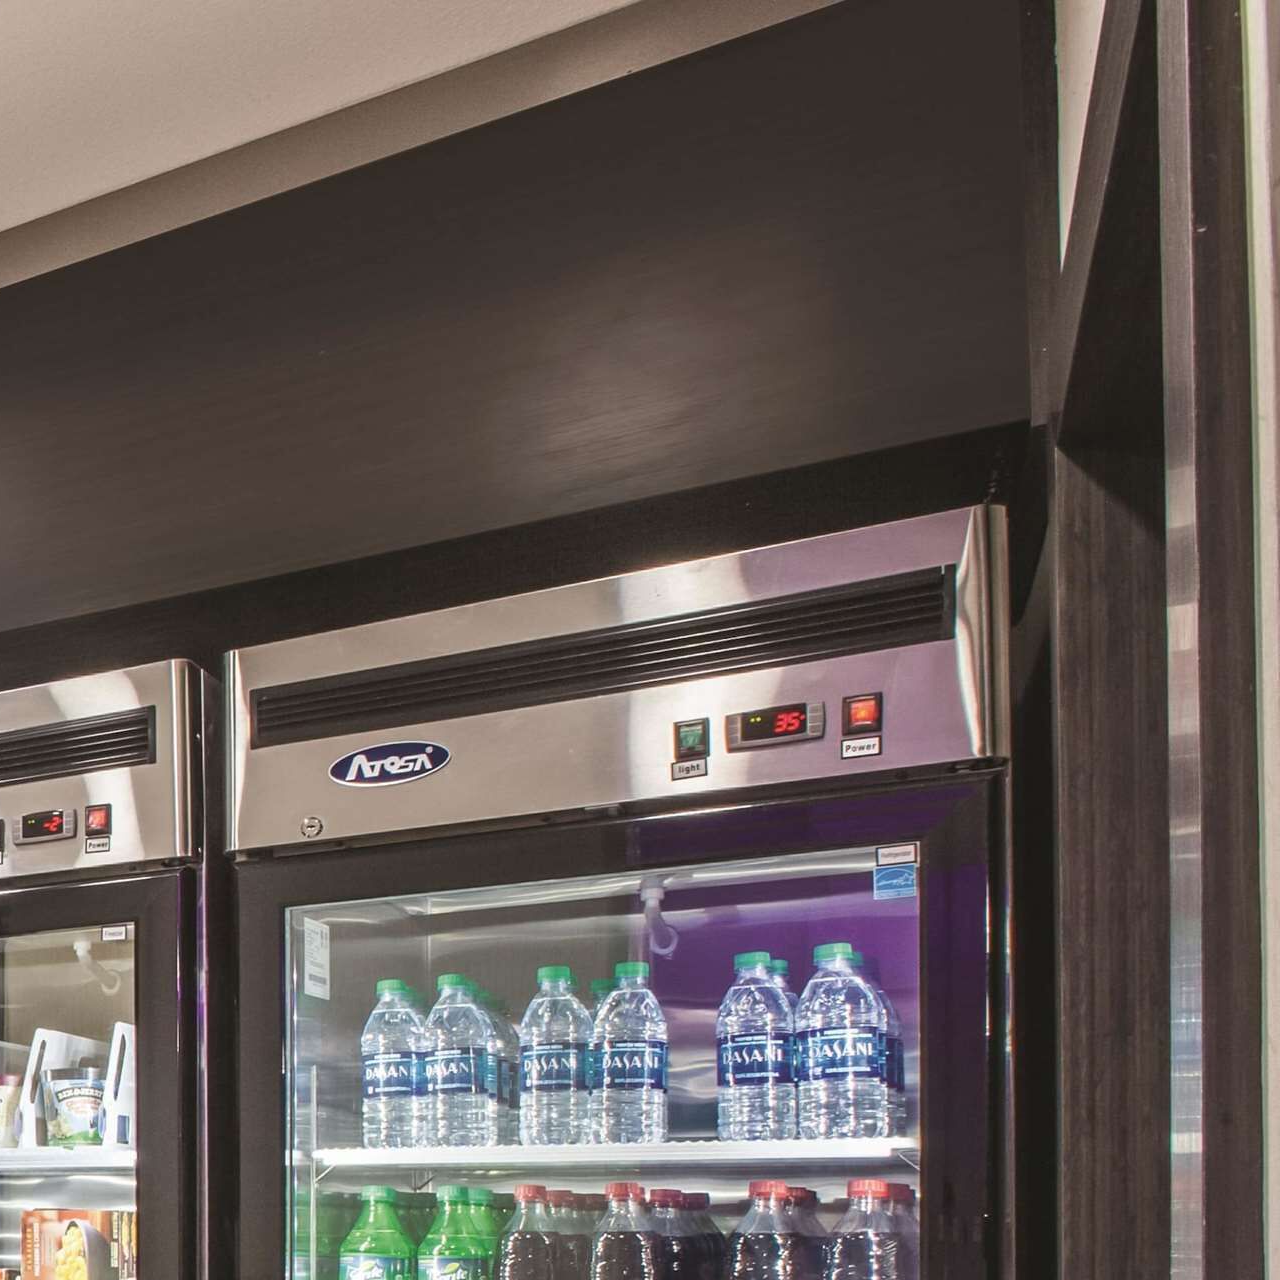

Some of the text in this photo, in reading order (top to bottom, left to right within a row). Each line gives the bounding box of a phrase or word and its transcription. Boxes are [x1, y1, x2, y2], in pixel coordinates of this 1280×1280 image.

[774, 712, 799, 734] 35
[845, 741, 877, 755] Power
[678, 761, 701, 778] light
[88, 841, 108, 852] Power
[723, 1046, 784, 1066] DASANI
[810, 1042, 873, 1060] DASANI
[602, 1054, 659, 1070] DASANI
